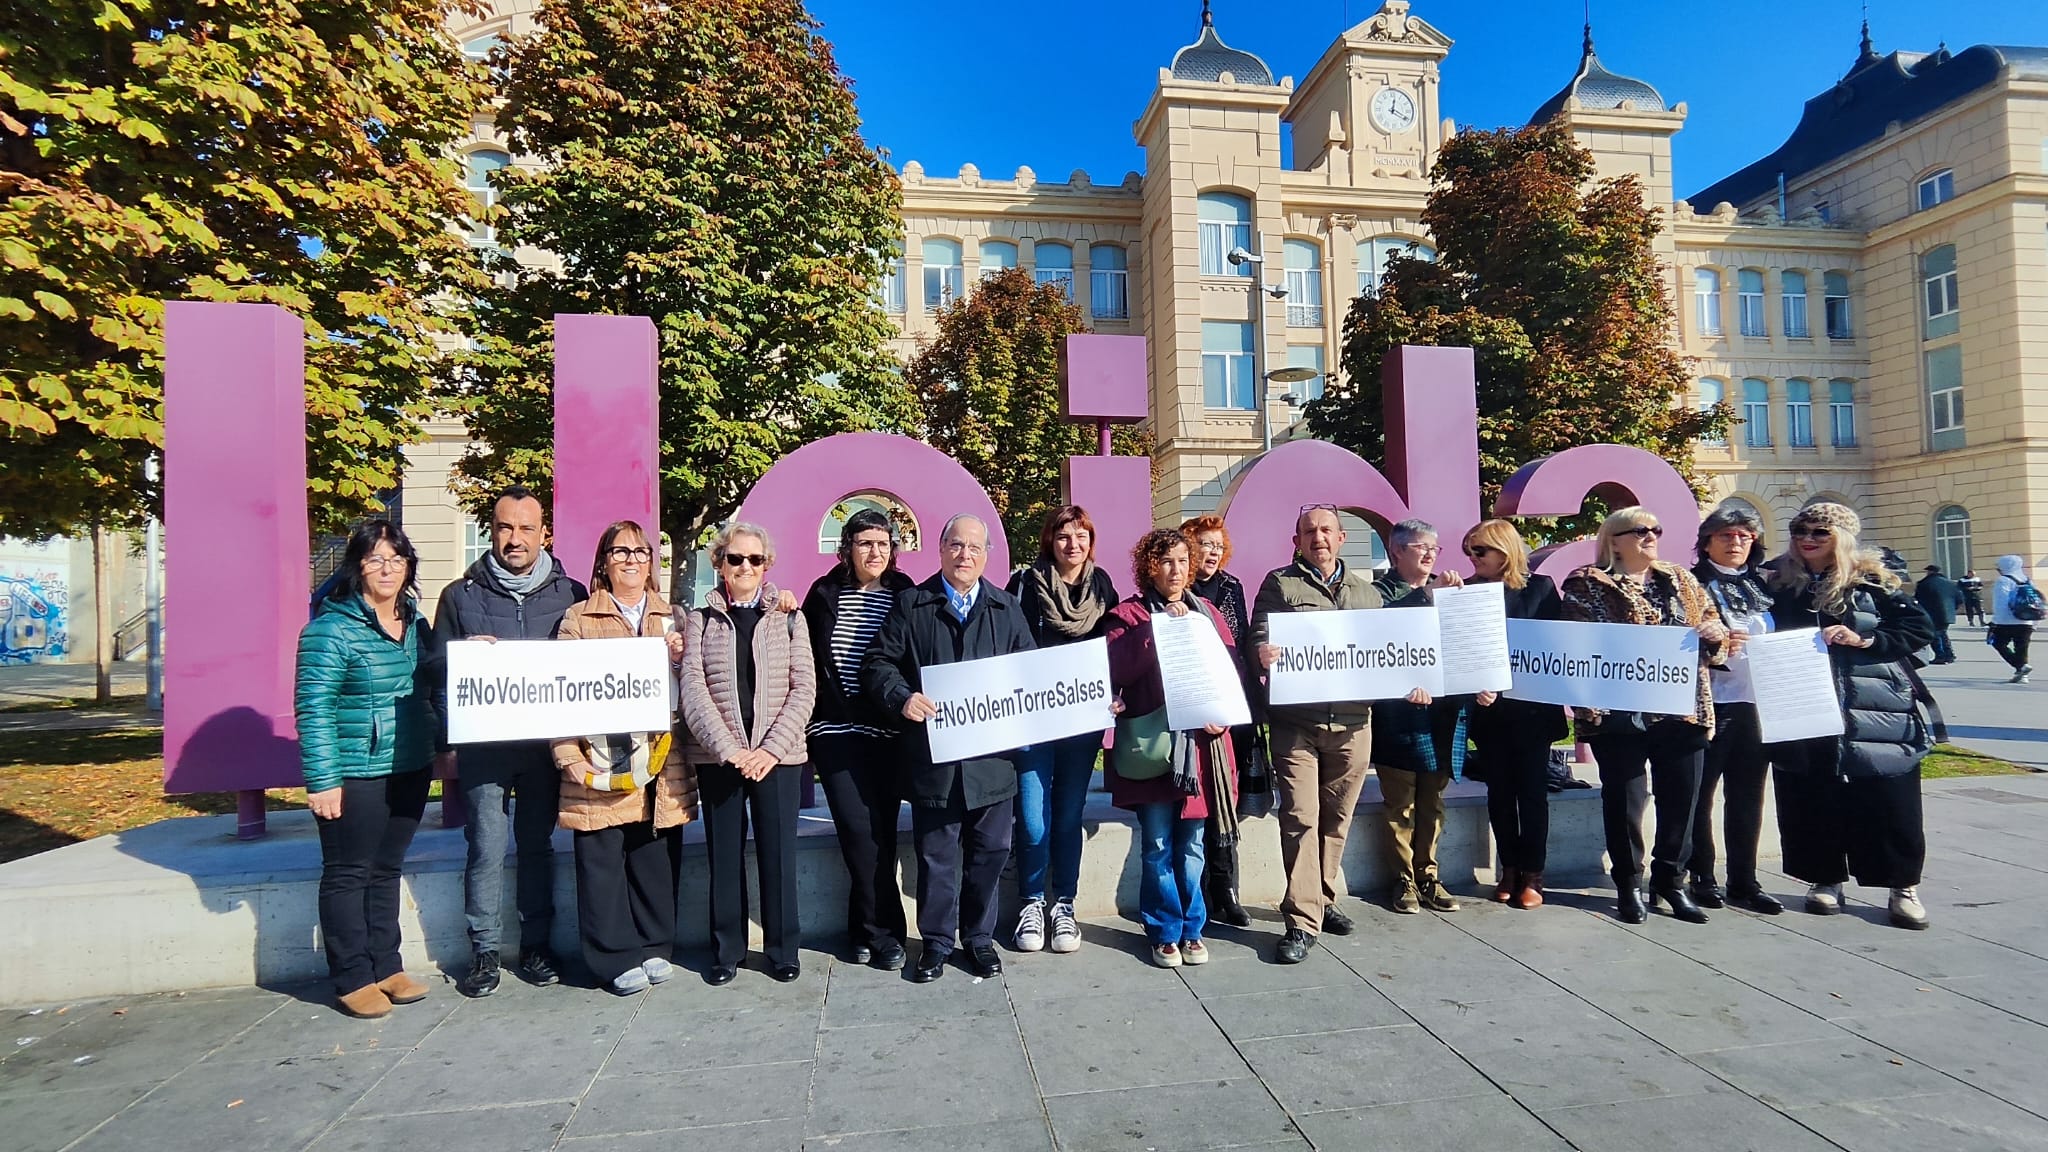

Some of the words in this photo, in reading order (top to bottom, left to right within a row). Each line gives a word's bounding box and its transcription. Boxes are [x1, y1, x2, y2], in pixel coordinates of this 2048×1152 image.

[1276, 641, 1437, 673] #NoVolemTorreSalses
[1510, 648, 1690, 685] #NoVolemTorreSalses
[456, 672, 662, 707] #NoVolemTorreSalses
[933, 677, 1106, 730] #NoVolemTorreSalses
